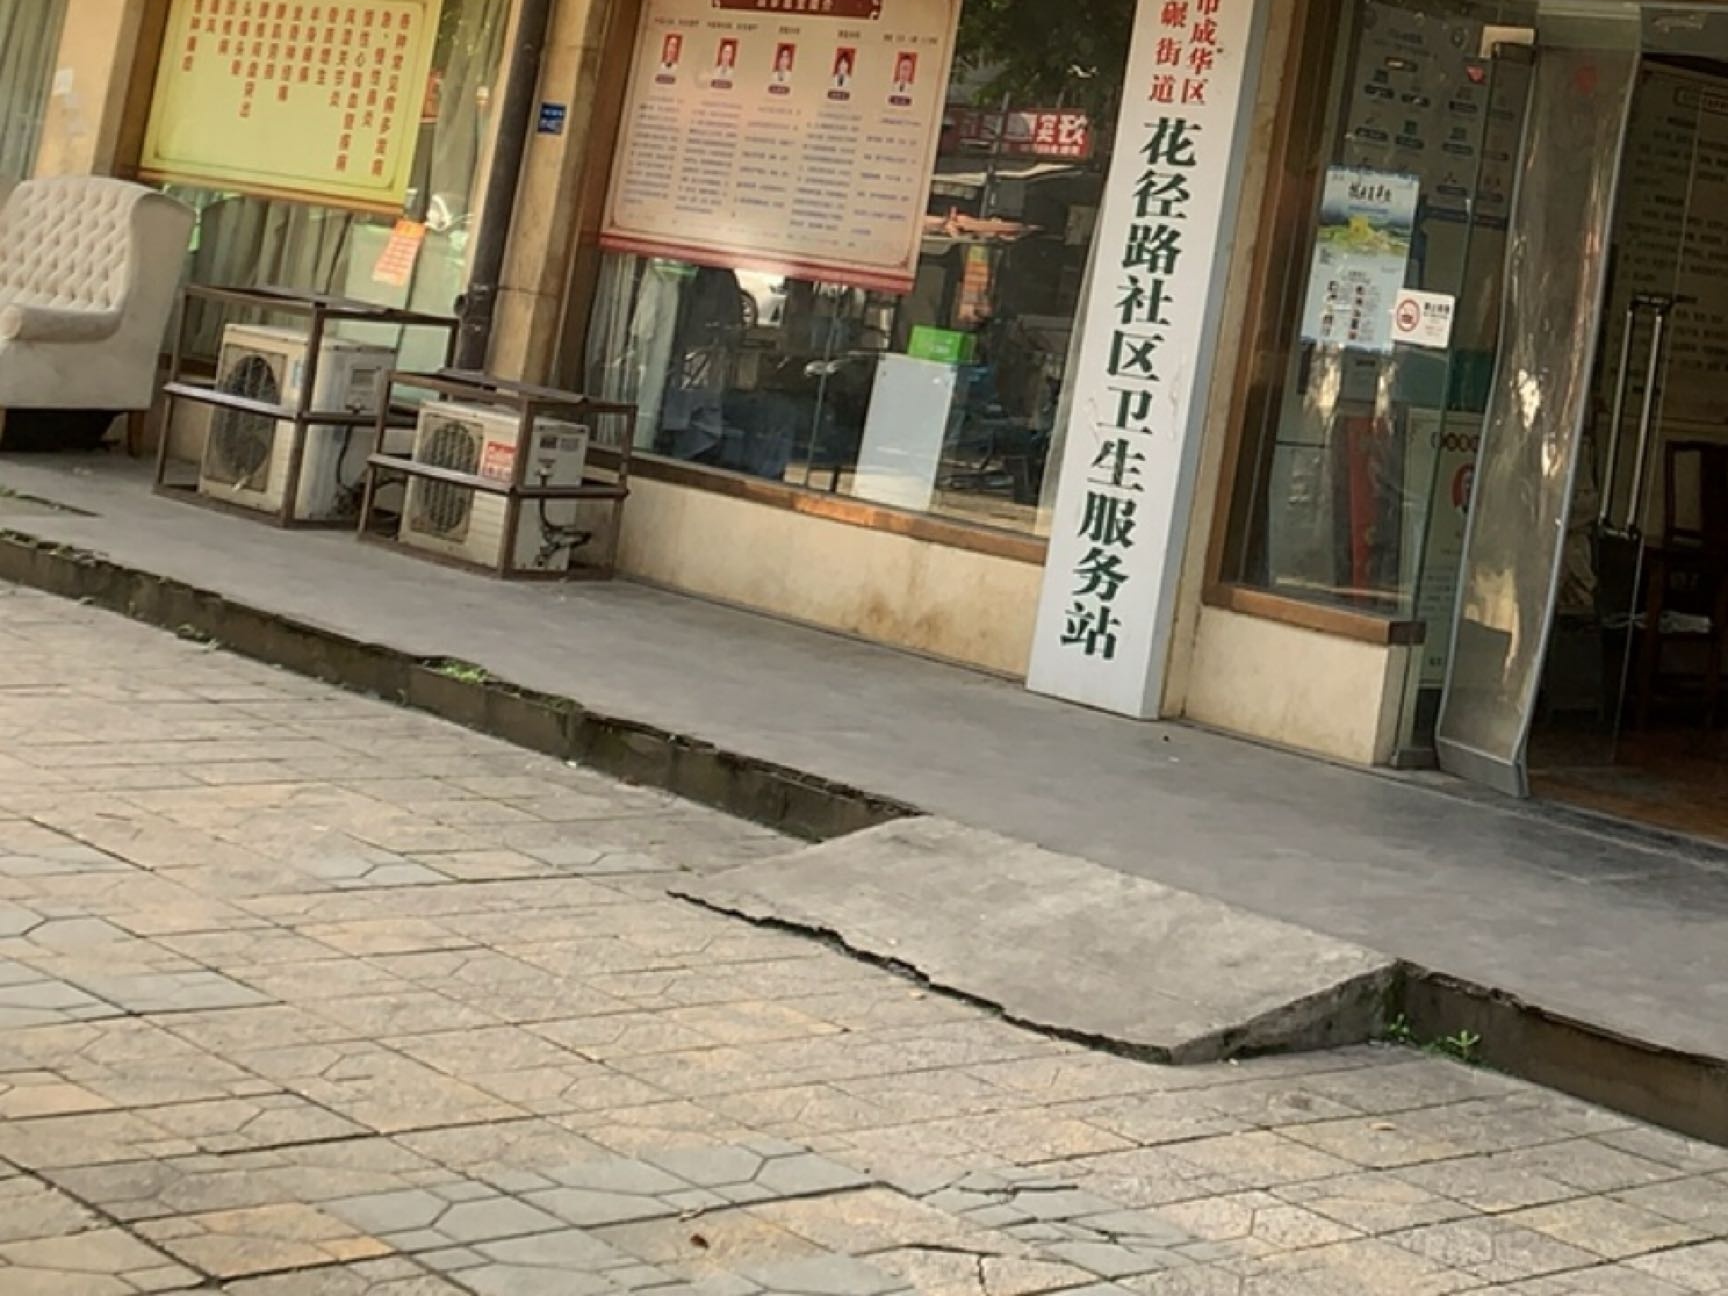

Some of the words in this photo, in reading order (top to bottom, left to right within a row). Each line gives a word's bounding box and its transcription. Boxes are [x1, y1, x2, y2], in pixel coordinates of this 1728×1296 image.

[1060, 116, 1203, 660] 花径路社区卫生服务站
